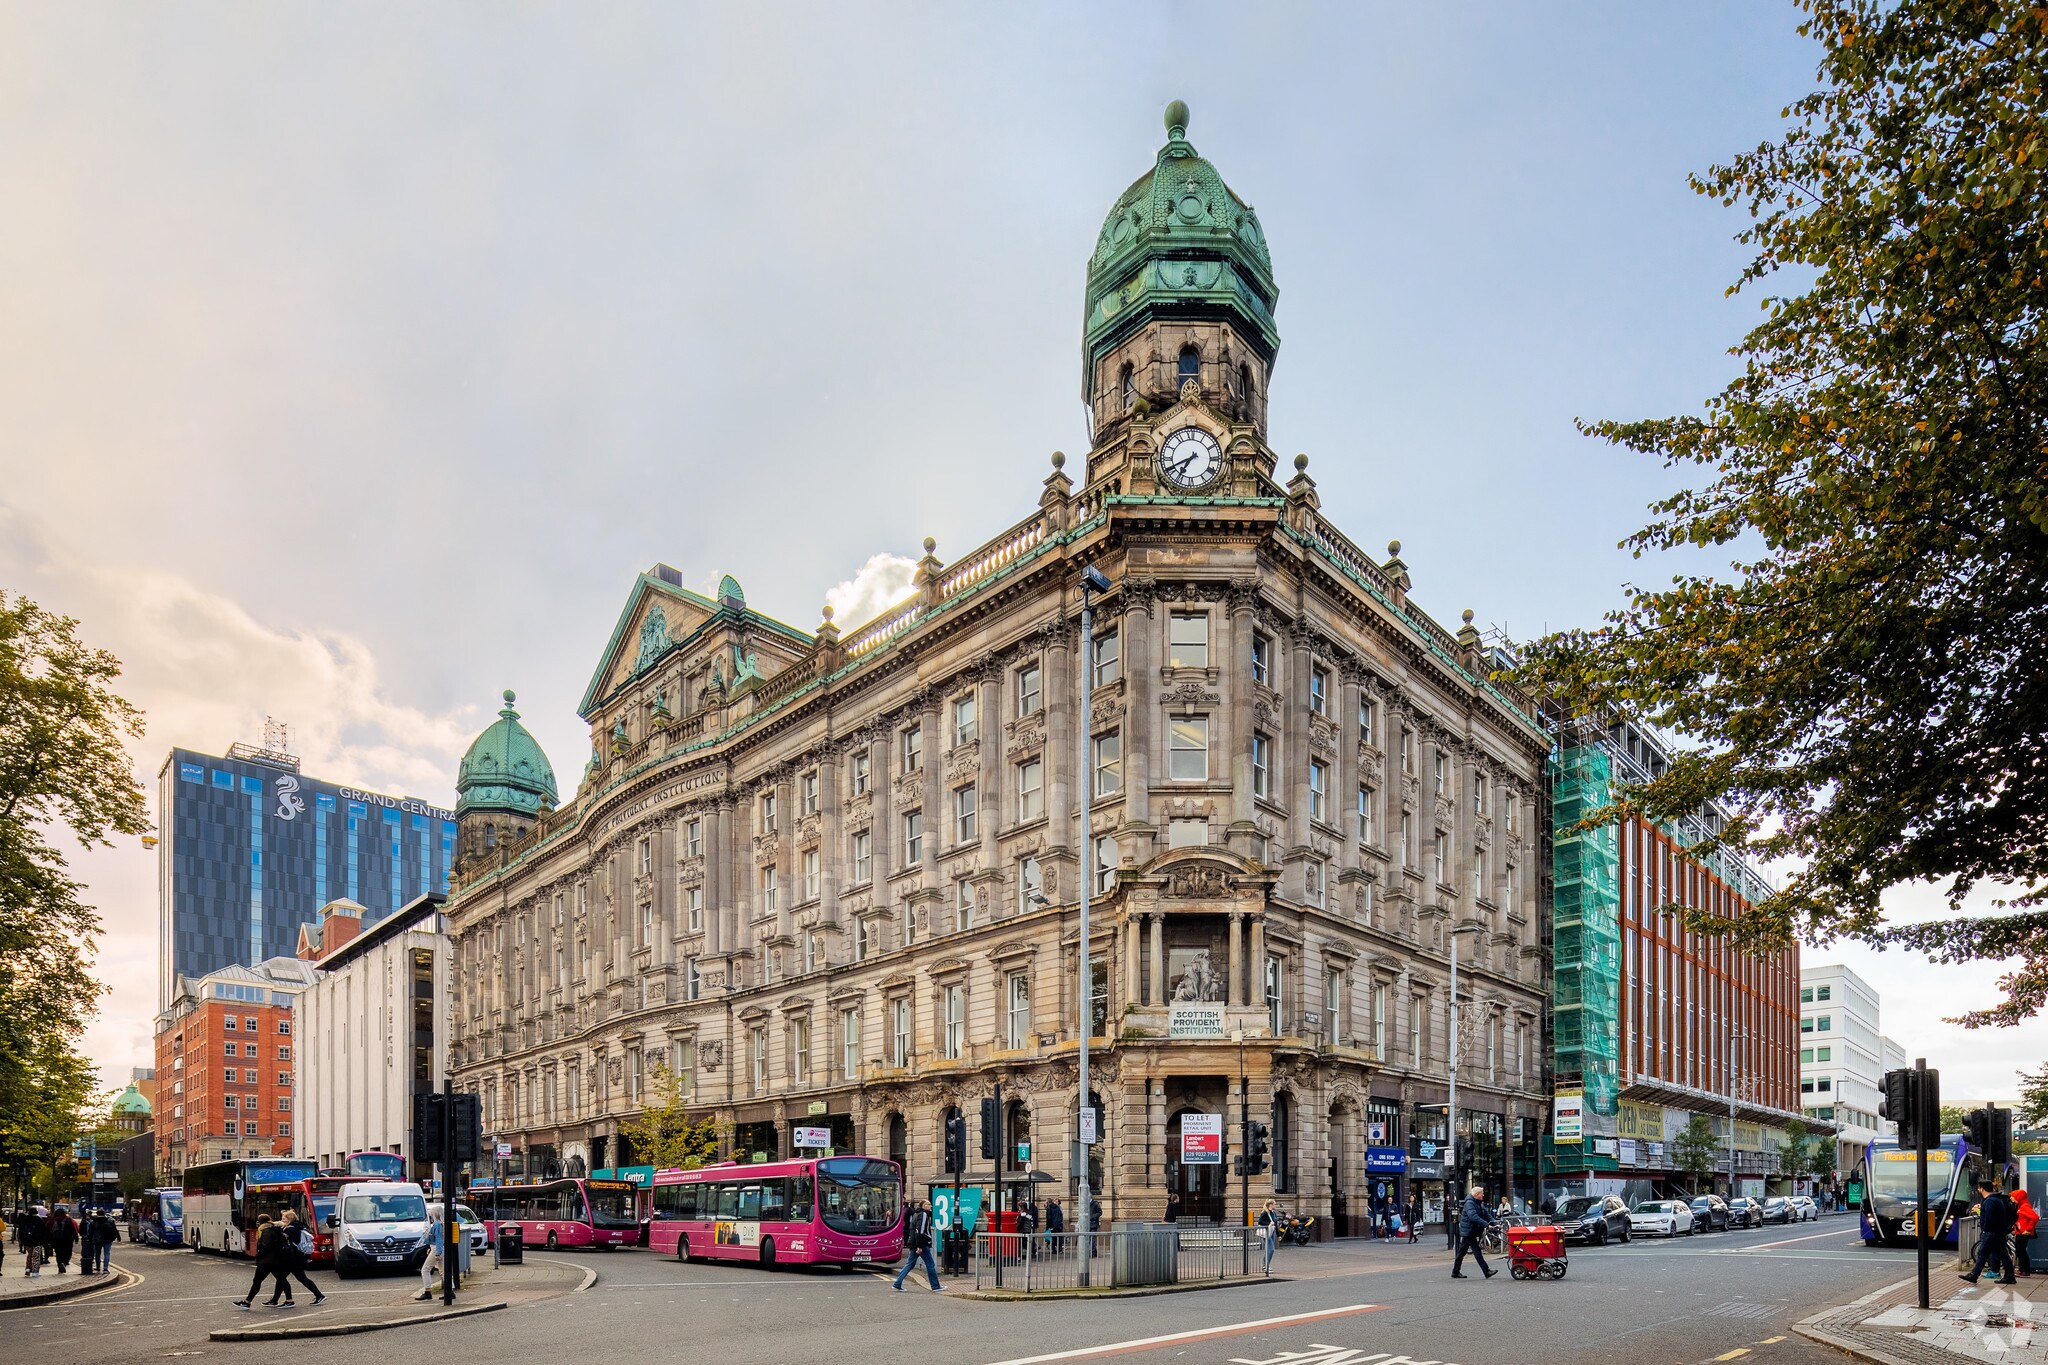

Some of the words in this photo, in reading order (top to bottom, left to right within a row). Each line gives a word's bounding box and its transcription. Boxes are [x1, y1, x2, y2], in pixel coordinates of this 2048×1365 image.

[339, 786, 396, 808] GRAND
[1171, 1026, 1223, 1034] INSTITUTION
[1639, 1108, 1660, 1122] BUSINESS
[1884, 1152, 1905, 1160] Titanic
[1934, 1152, 1946, 1161] G2
[624, 1172, 645, 1182] Centra
[935, 1195, 948, 1230] 3
